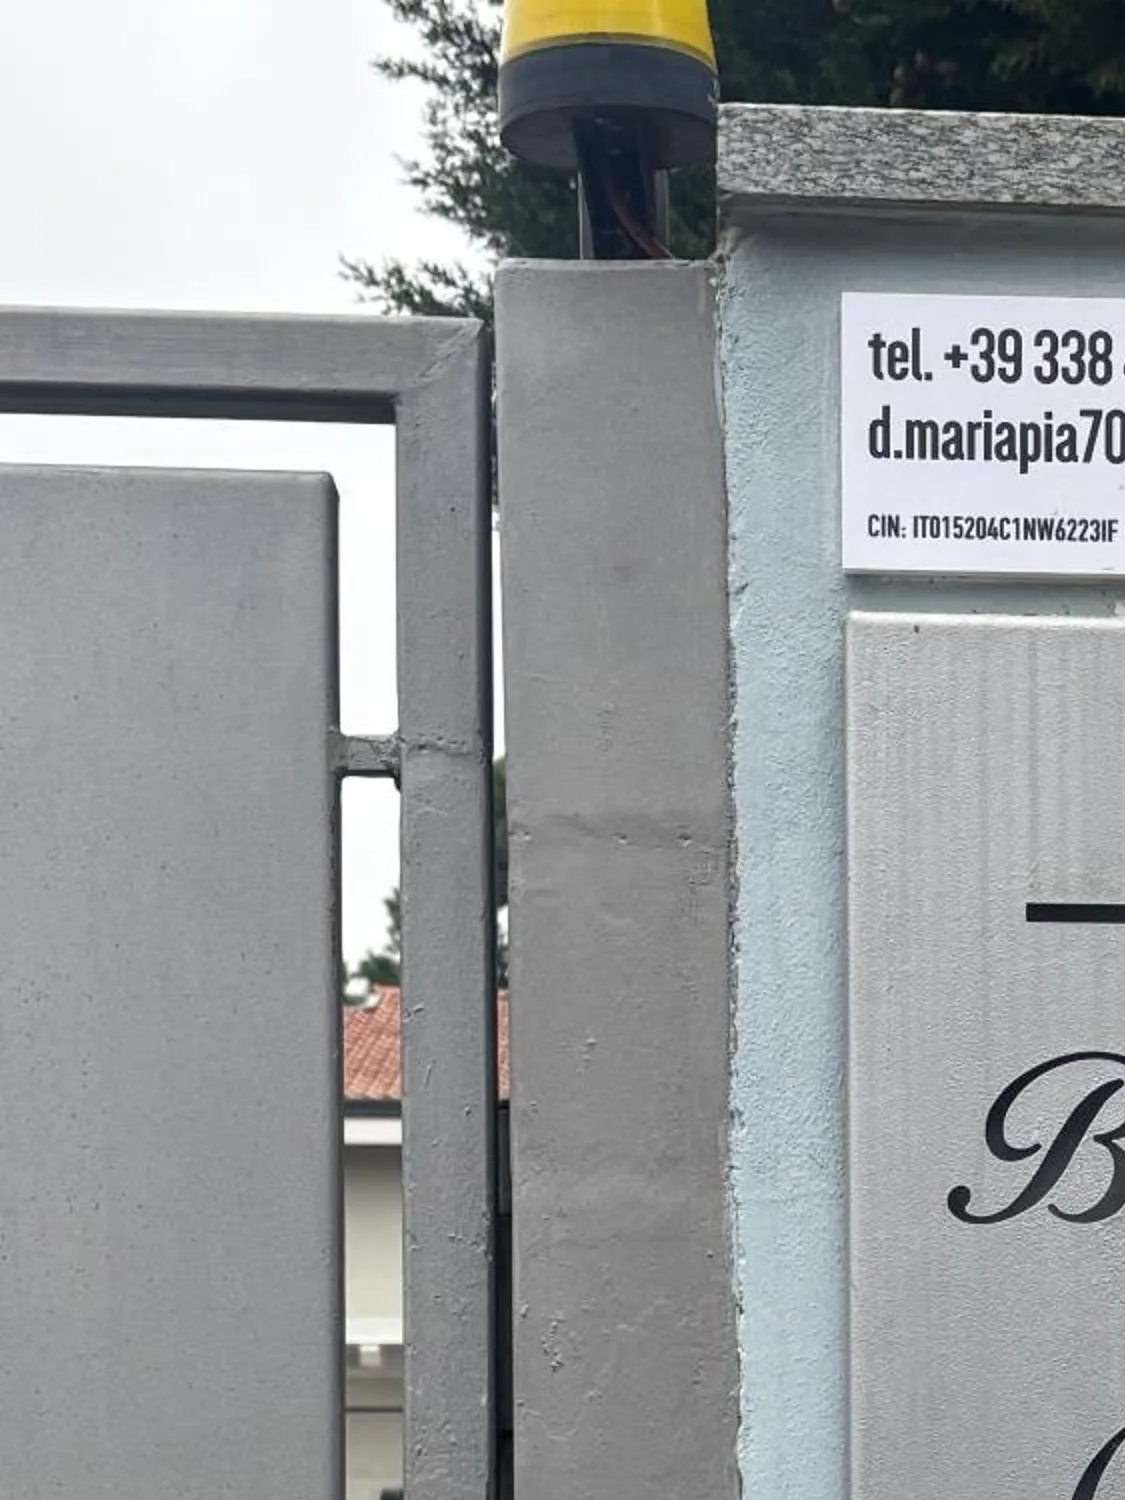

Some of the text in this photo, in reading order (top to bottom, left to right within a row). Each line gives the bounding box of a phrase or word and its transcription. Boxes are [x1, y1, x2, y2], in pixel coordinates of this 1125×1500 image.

[867, 326, 933, 382] tel.
[943, 327, 1024, 385] +39
[1033, 328, 1113, 386] 338
[867, 514, 907, 539] CIN:
